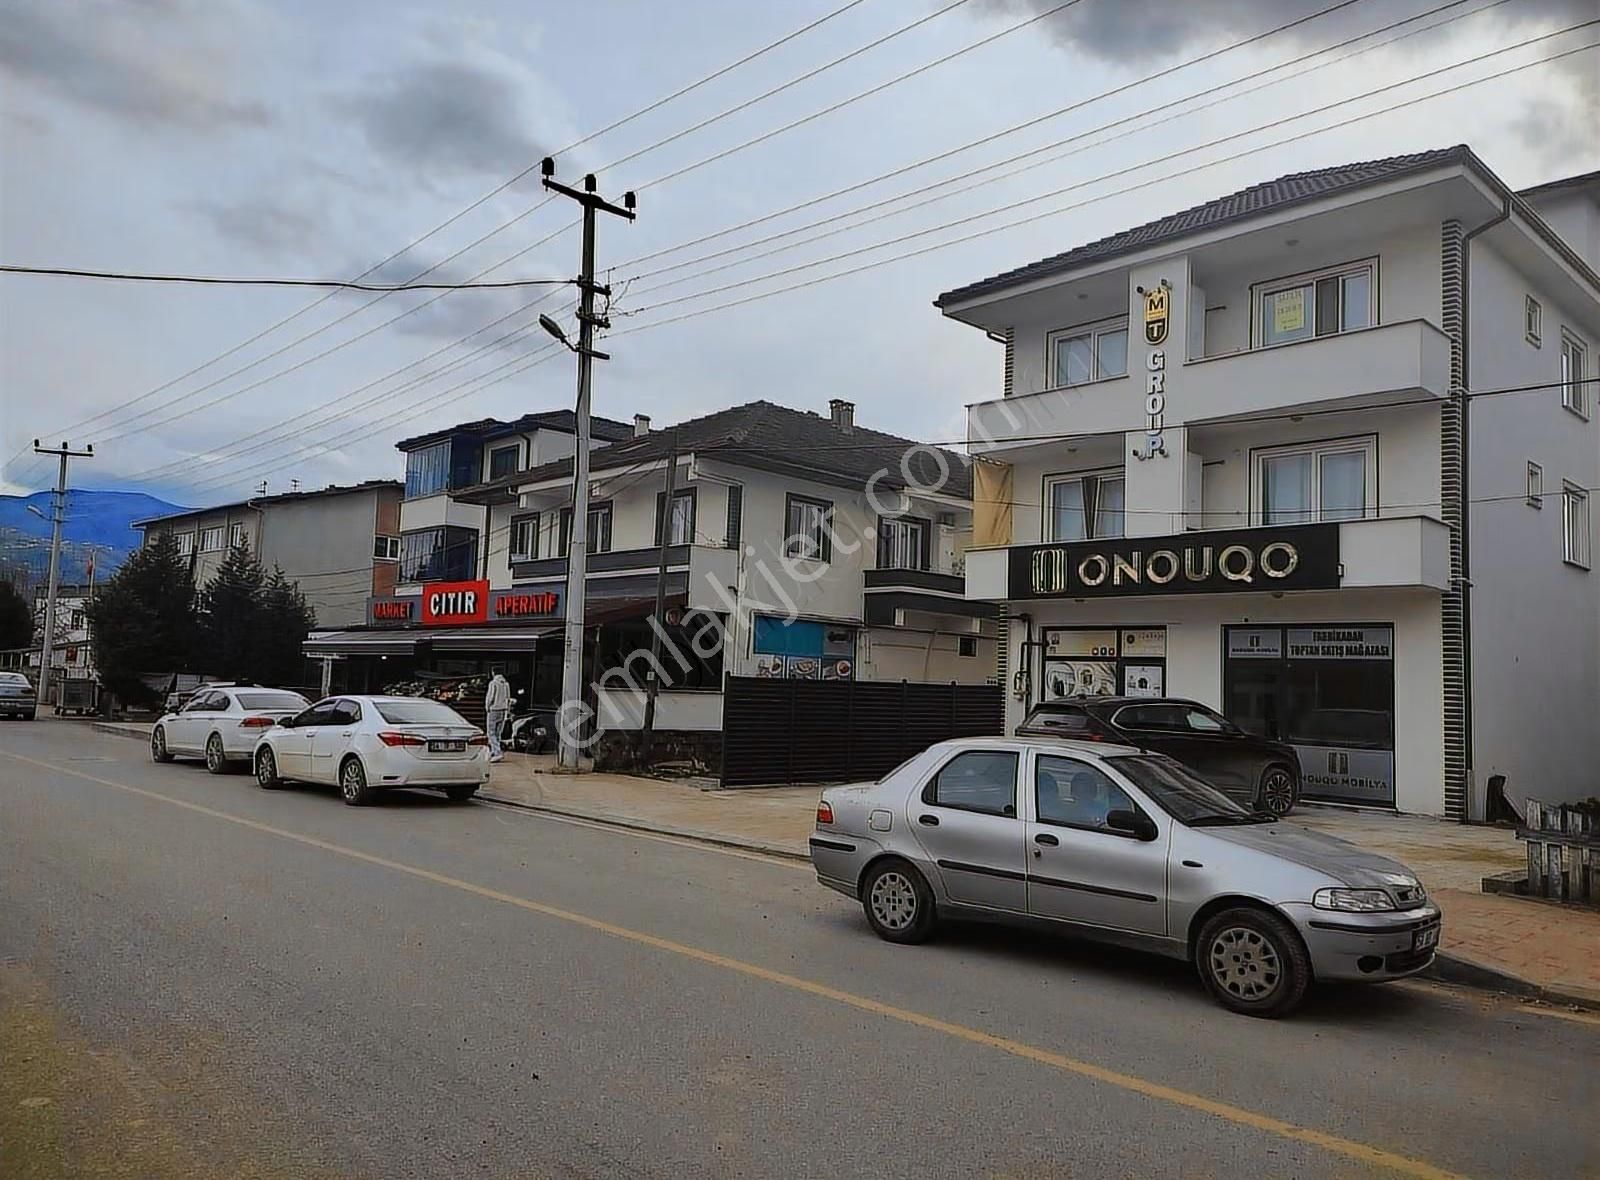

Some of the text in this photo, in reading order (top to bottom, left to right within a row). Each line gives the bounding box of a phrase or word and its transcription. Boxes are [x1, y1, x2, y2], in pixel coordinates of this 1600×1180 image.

[1146, 349, 1165, 459] GROUP
[1078, 541, 1298, 587] ONOUQO
[374, 601, 412, 619] MARKET
[1290, 645, 1320, 656] TOPTAN
